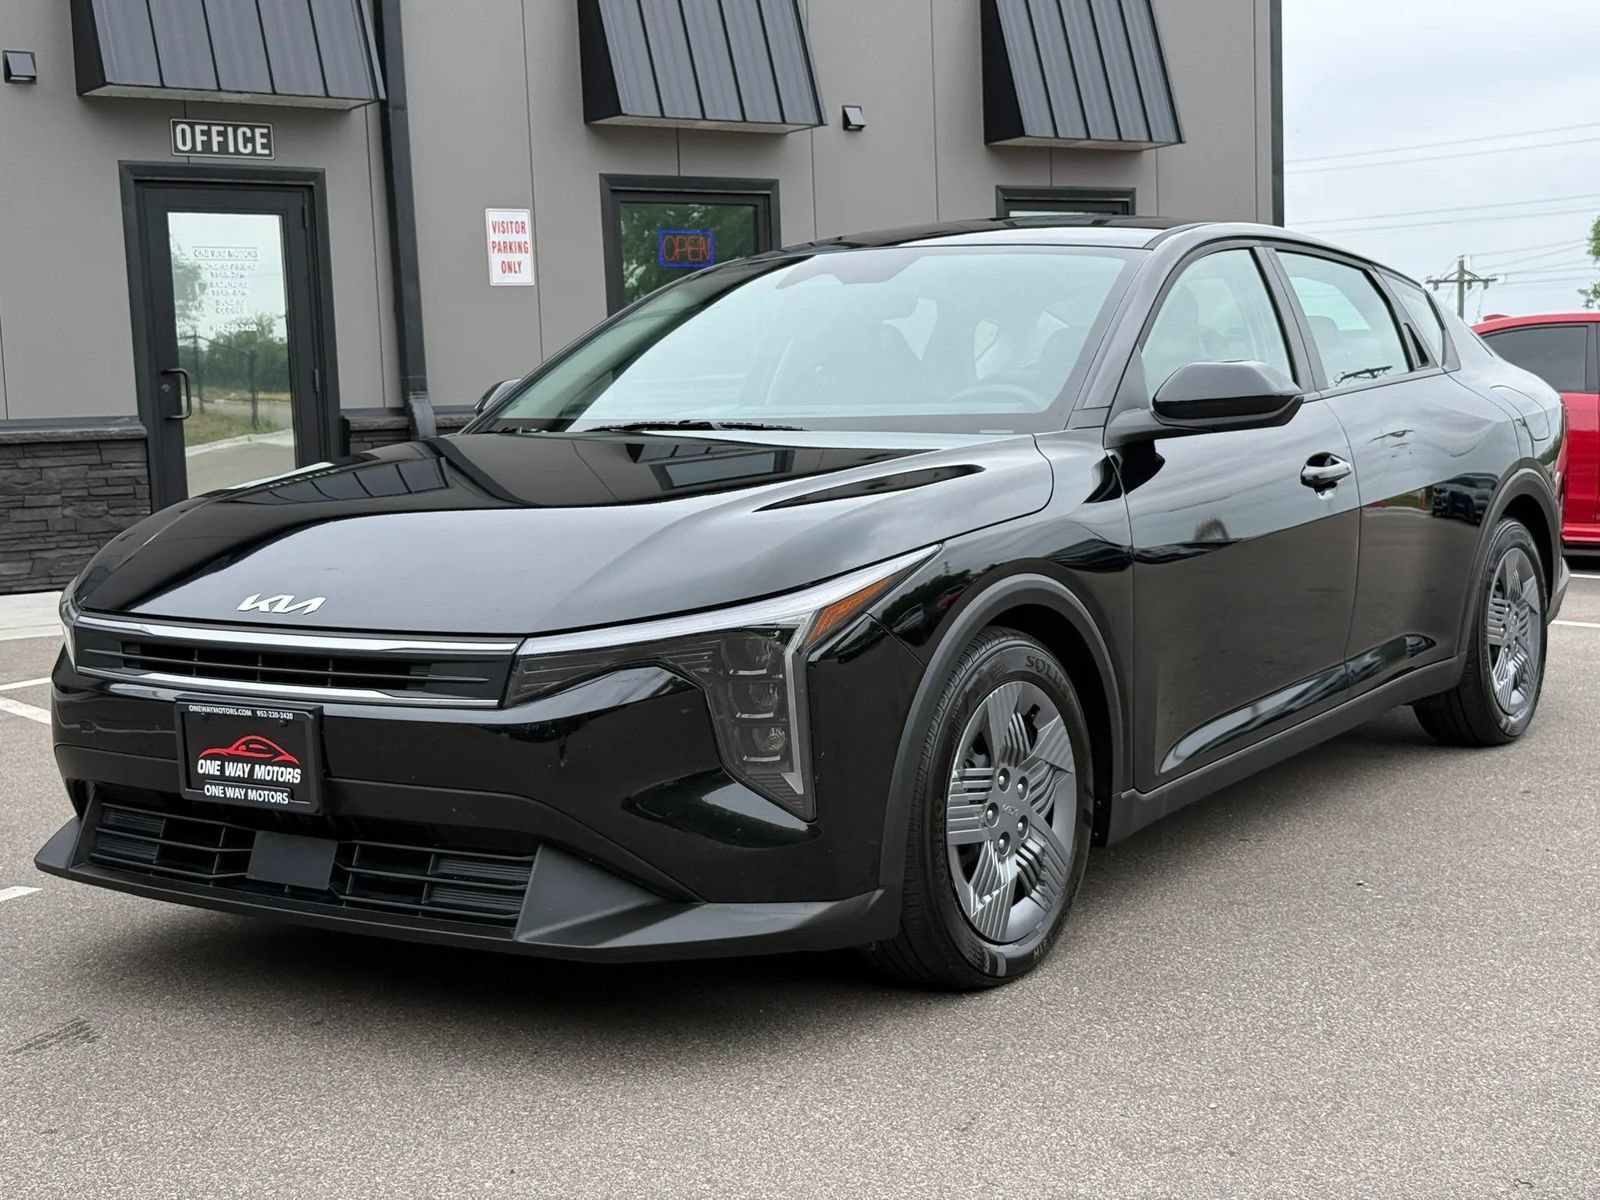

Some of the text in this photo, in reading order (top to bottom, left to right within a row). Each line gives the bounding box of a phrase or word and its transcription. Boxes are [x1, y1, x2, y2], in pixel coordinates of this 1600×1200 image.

[175, 123, 270, 155] OFFICE
[491, 220, 527, 234] VISITOR
[491, 240, 529, 254] PARKING
[663, 235, 710, 261] OPEN
[501, 260, 522, 274] ONLY
[188, 704, 253, 717] ONEWAYMOTORS.COM
[197, 759, 302, 784] ONE WAY MOTORS
[204, 784, 289, 805] ONE WAY MOTORS
